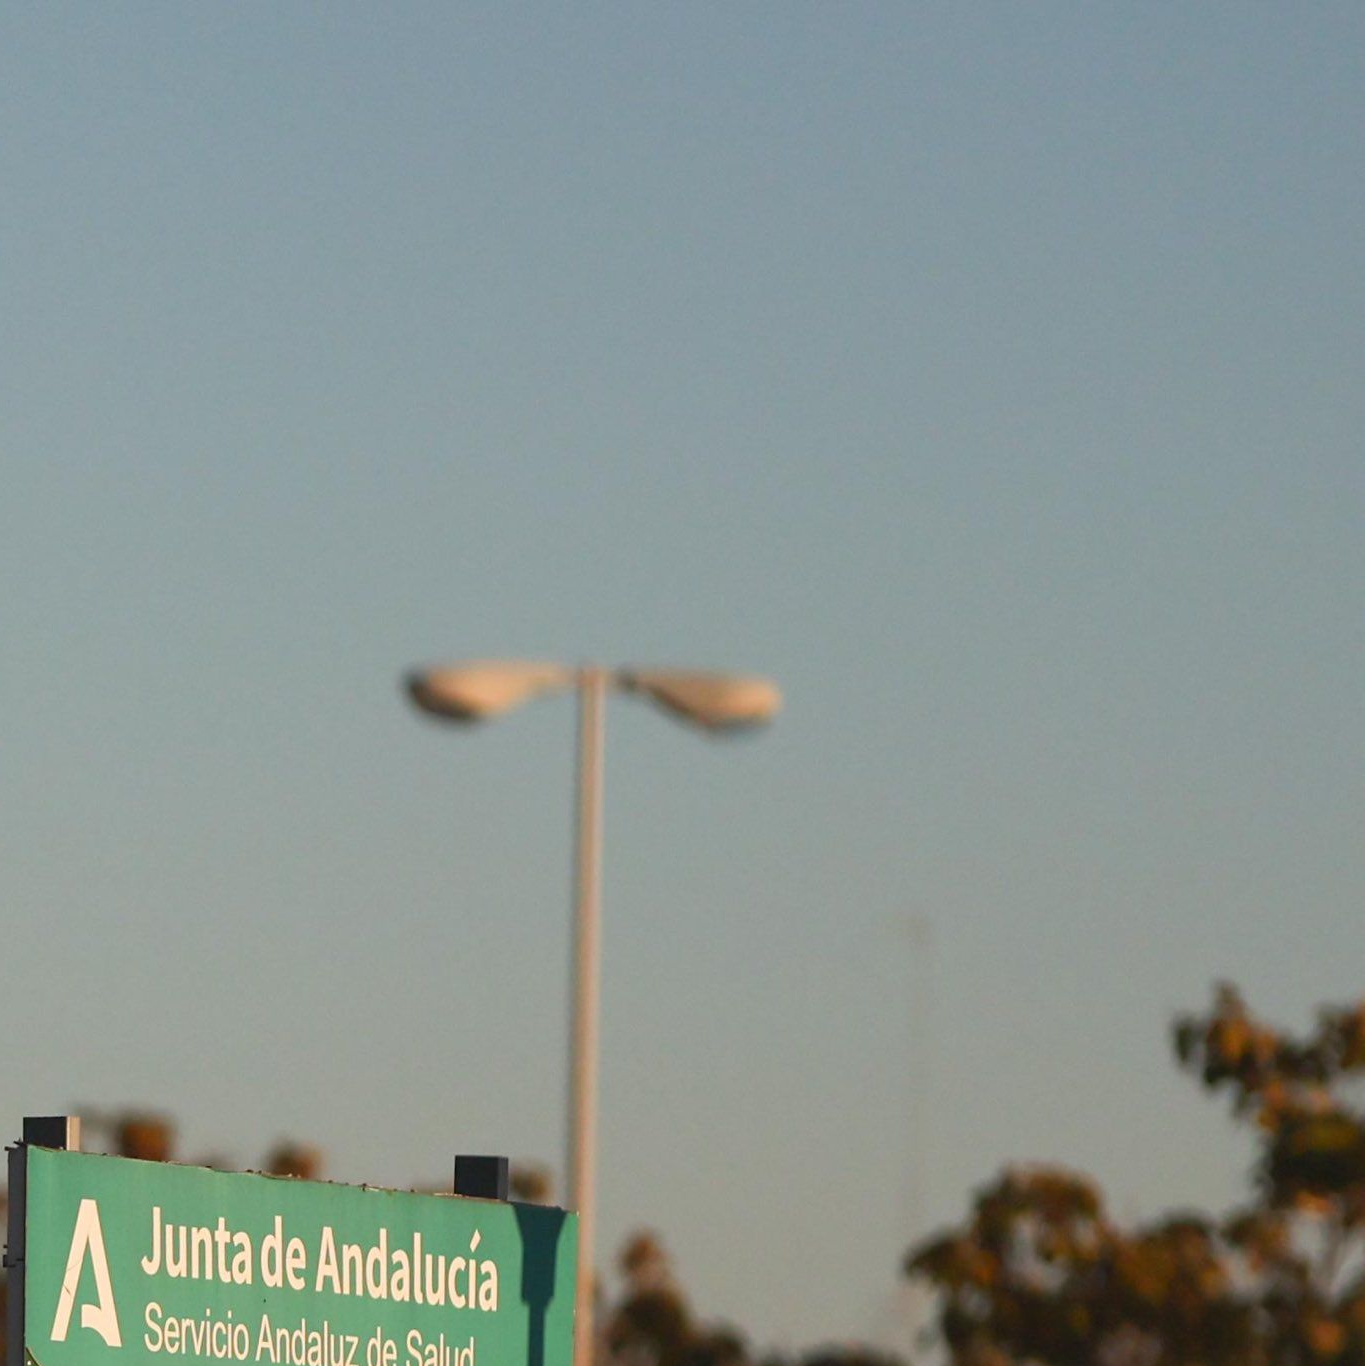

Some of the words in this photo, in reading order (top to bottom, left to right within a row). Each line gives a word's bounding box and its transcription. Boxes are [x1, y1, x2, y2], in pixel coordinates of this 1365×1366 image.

[141, 1207, 251, 1284] Junta
[261, 1216, 305, 1290] de
[316, 1227, 498, 1311] Andalucía
[145, 1302, 249, 1360] Servicio
